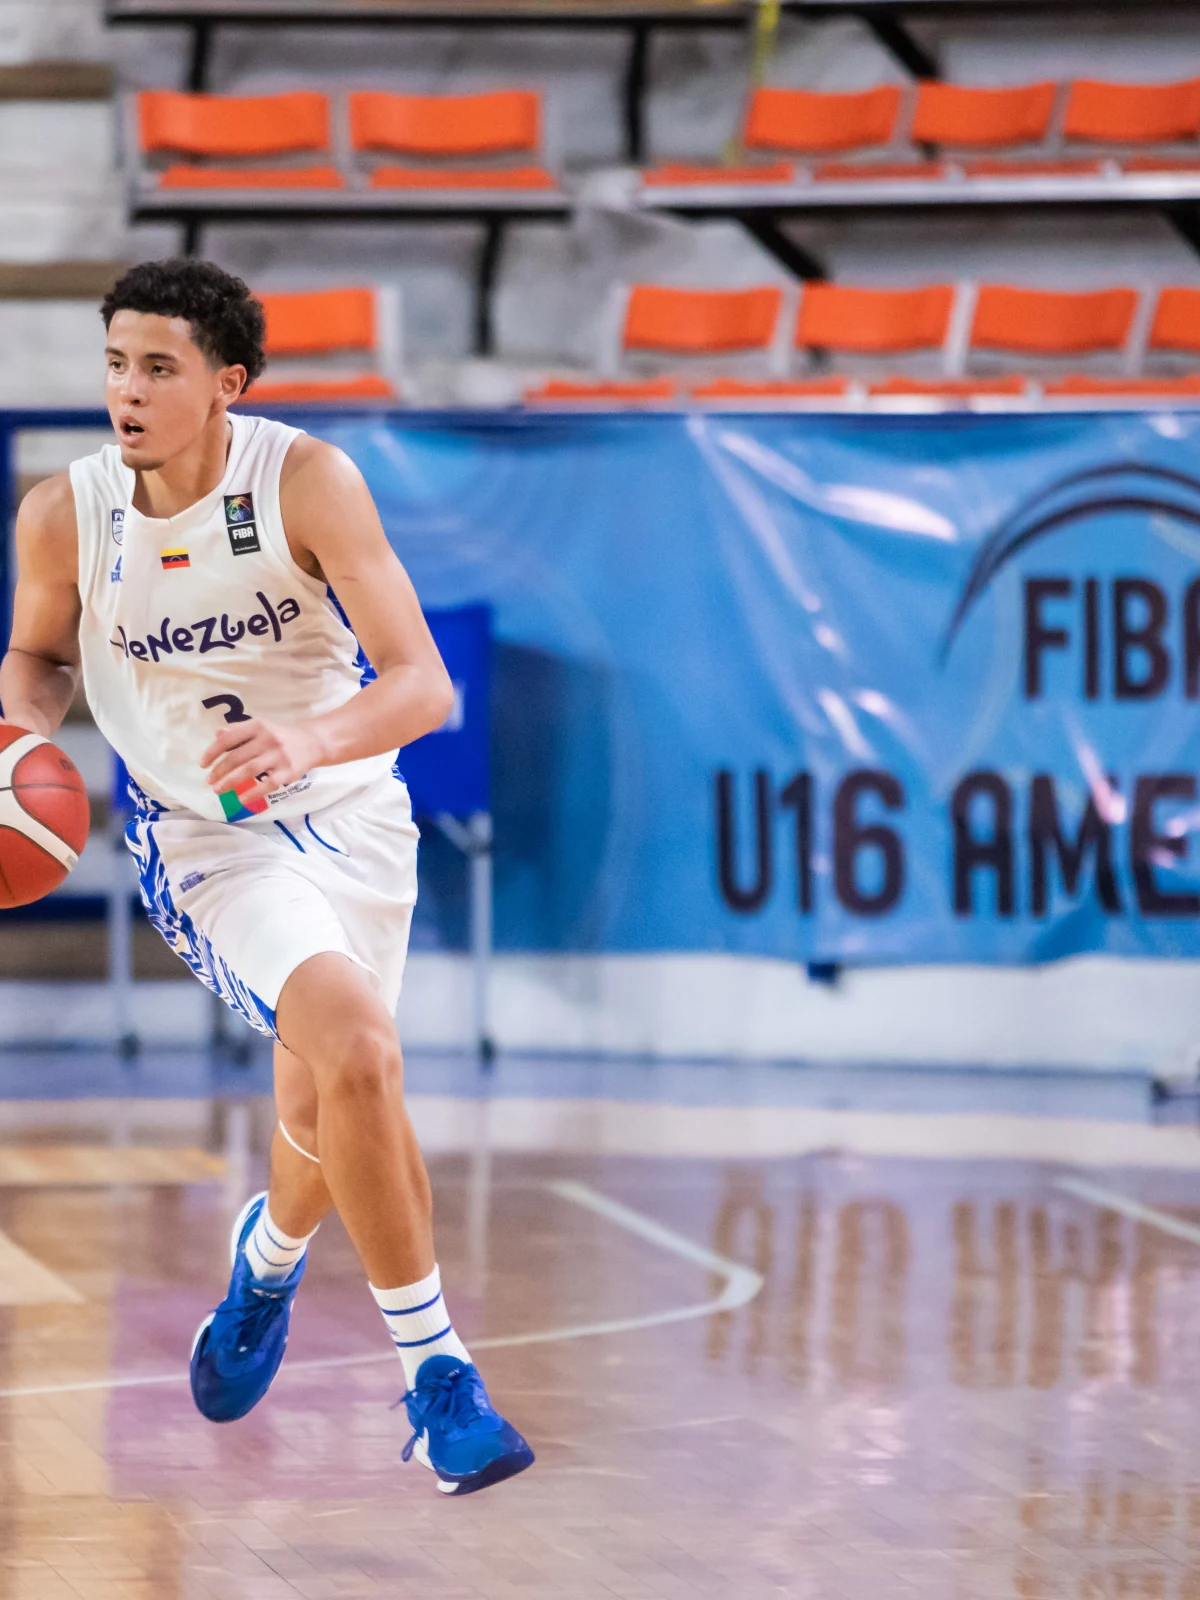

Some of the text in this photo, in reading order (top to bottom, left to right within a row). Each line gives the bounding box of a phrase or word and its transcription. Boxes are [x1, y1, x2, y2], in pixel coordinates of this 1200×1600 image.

[232, 526, 254, 540] FIBA
[1024, 575, 1200, 700] FIB
[714, 769, 1200, 919] U16 AME
